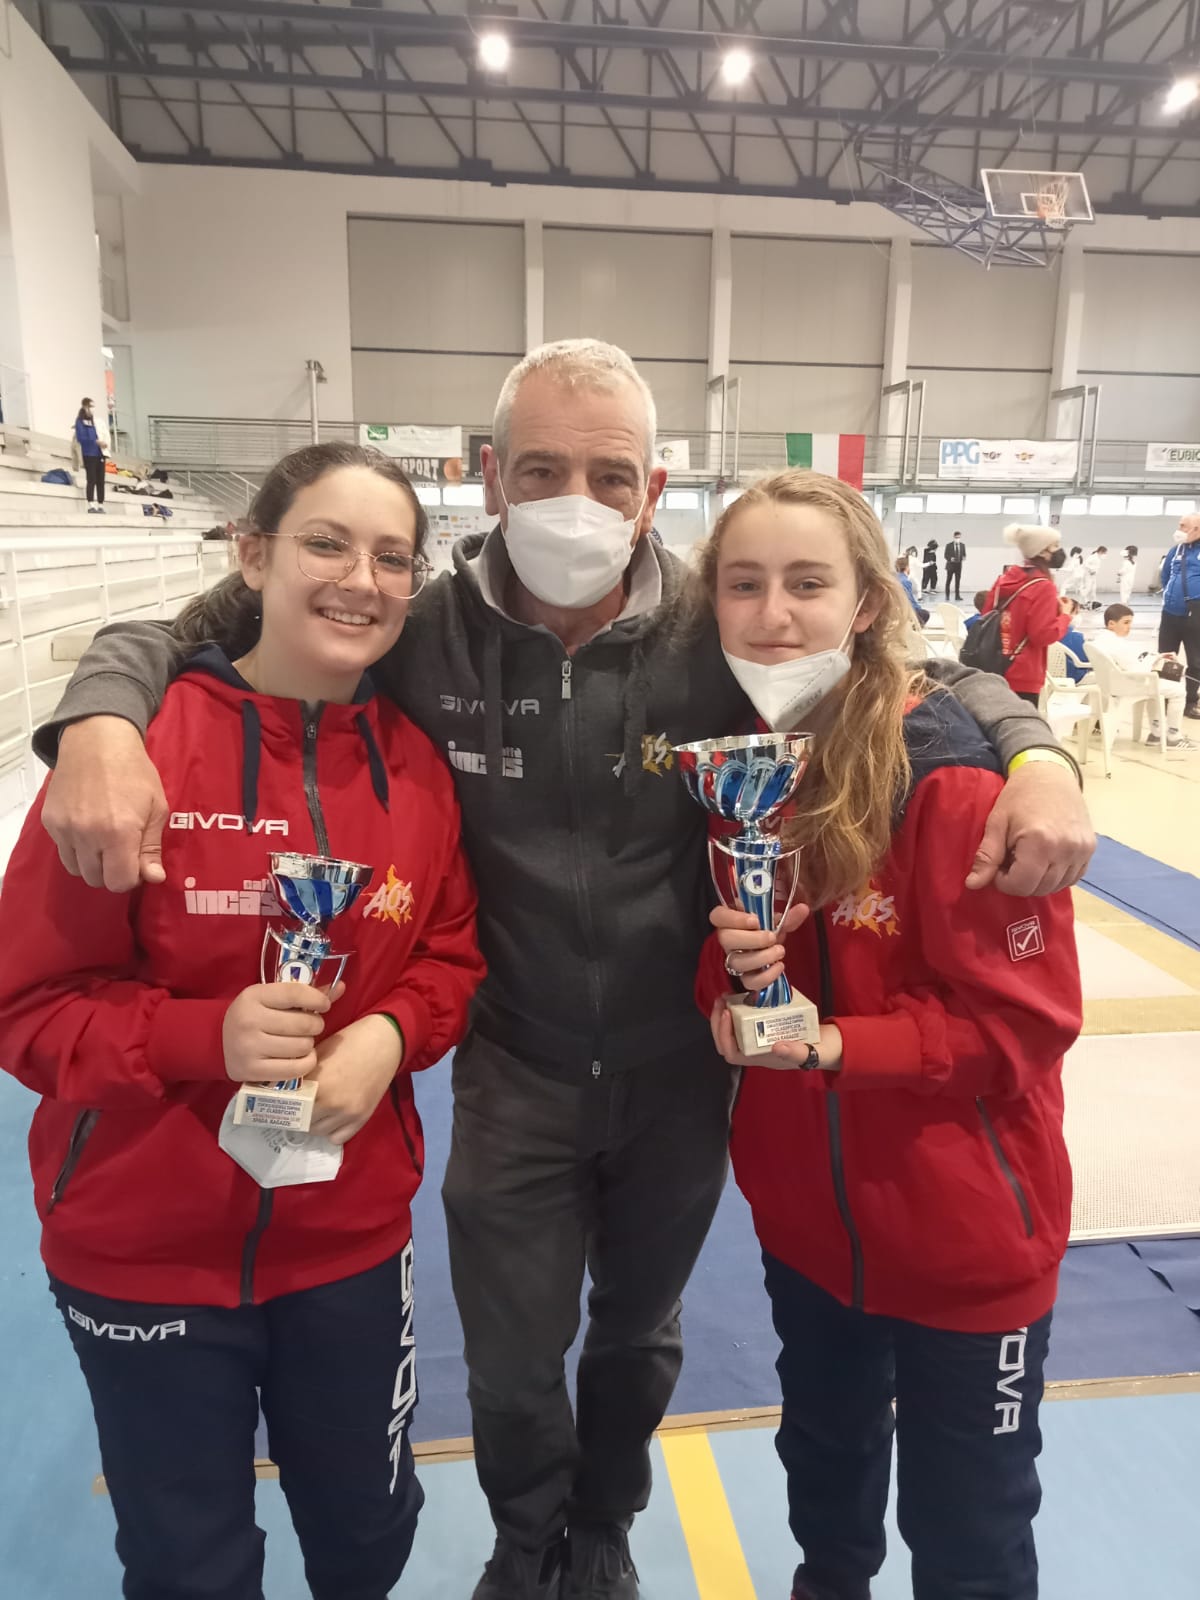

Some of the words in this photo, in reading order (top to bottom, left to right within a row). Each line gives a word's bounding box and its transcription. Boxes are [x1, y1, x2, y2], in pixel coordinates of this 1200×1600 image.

[941, 441, 980, 465] PPG
[440, 694, 540, 716] GIVVA
[169, 811, 289, 836] GIVOVA
[68, 1305, 186, 1342] GIVOVA
[992, 1326, 1029, 1436] OVA
